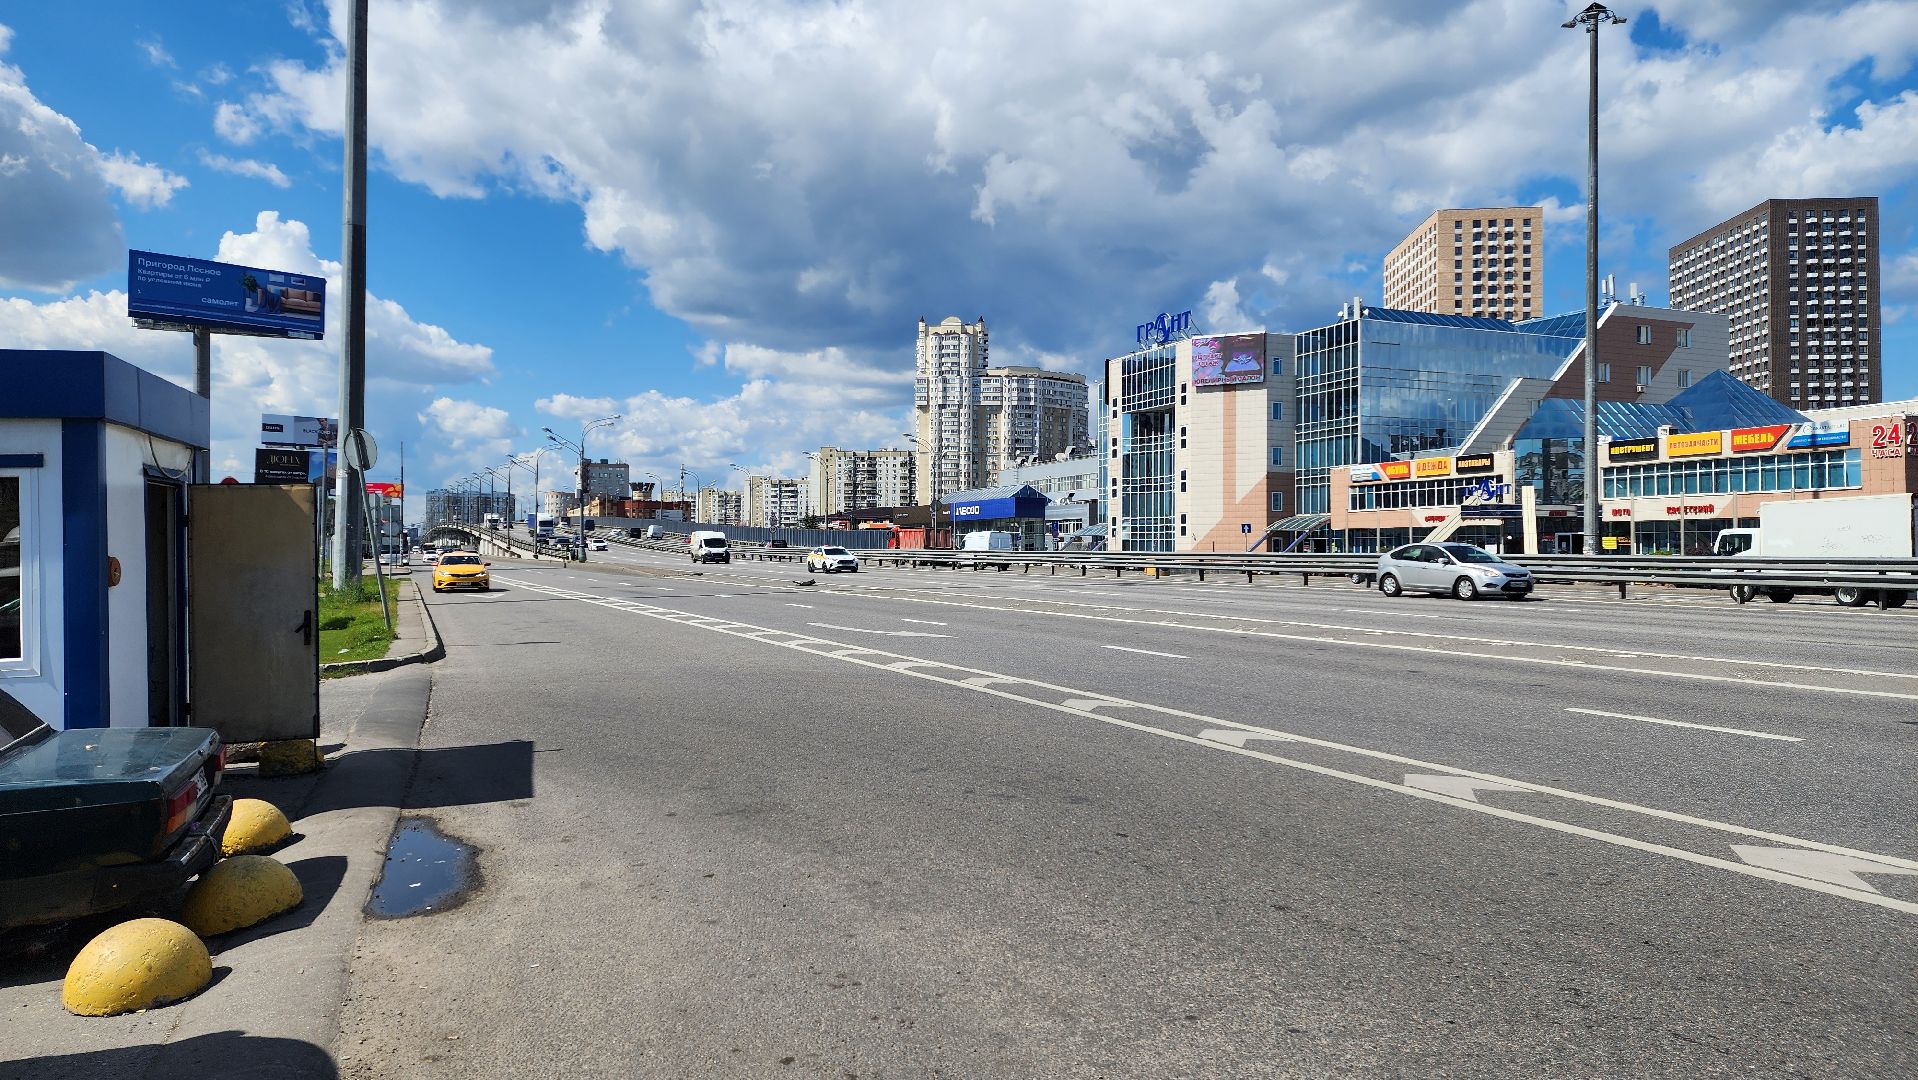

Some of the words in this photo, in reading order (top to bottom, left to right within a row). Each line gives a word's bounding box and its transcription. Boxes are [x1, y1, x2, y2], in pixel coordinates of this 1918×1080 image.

[138, 258, 185, 271] Пригород
[1136, 311, 1191, 344] ГРАНТ
[1734, 433, 1775, 445] МЕБЕЛЬ
[1872, 423, 1902, 447] 24
[1871, 449, 1901, 457] ЧАСА
[1416, 460, 1448, 472] ОДЕЖДА
[1463, 478, 1512, 501] ГРАНТ
